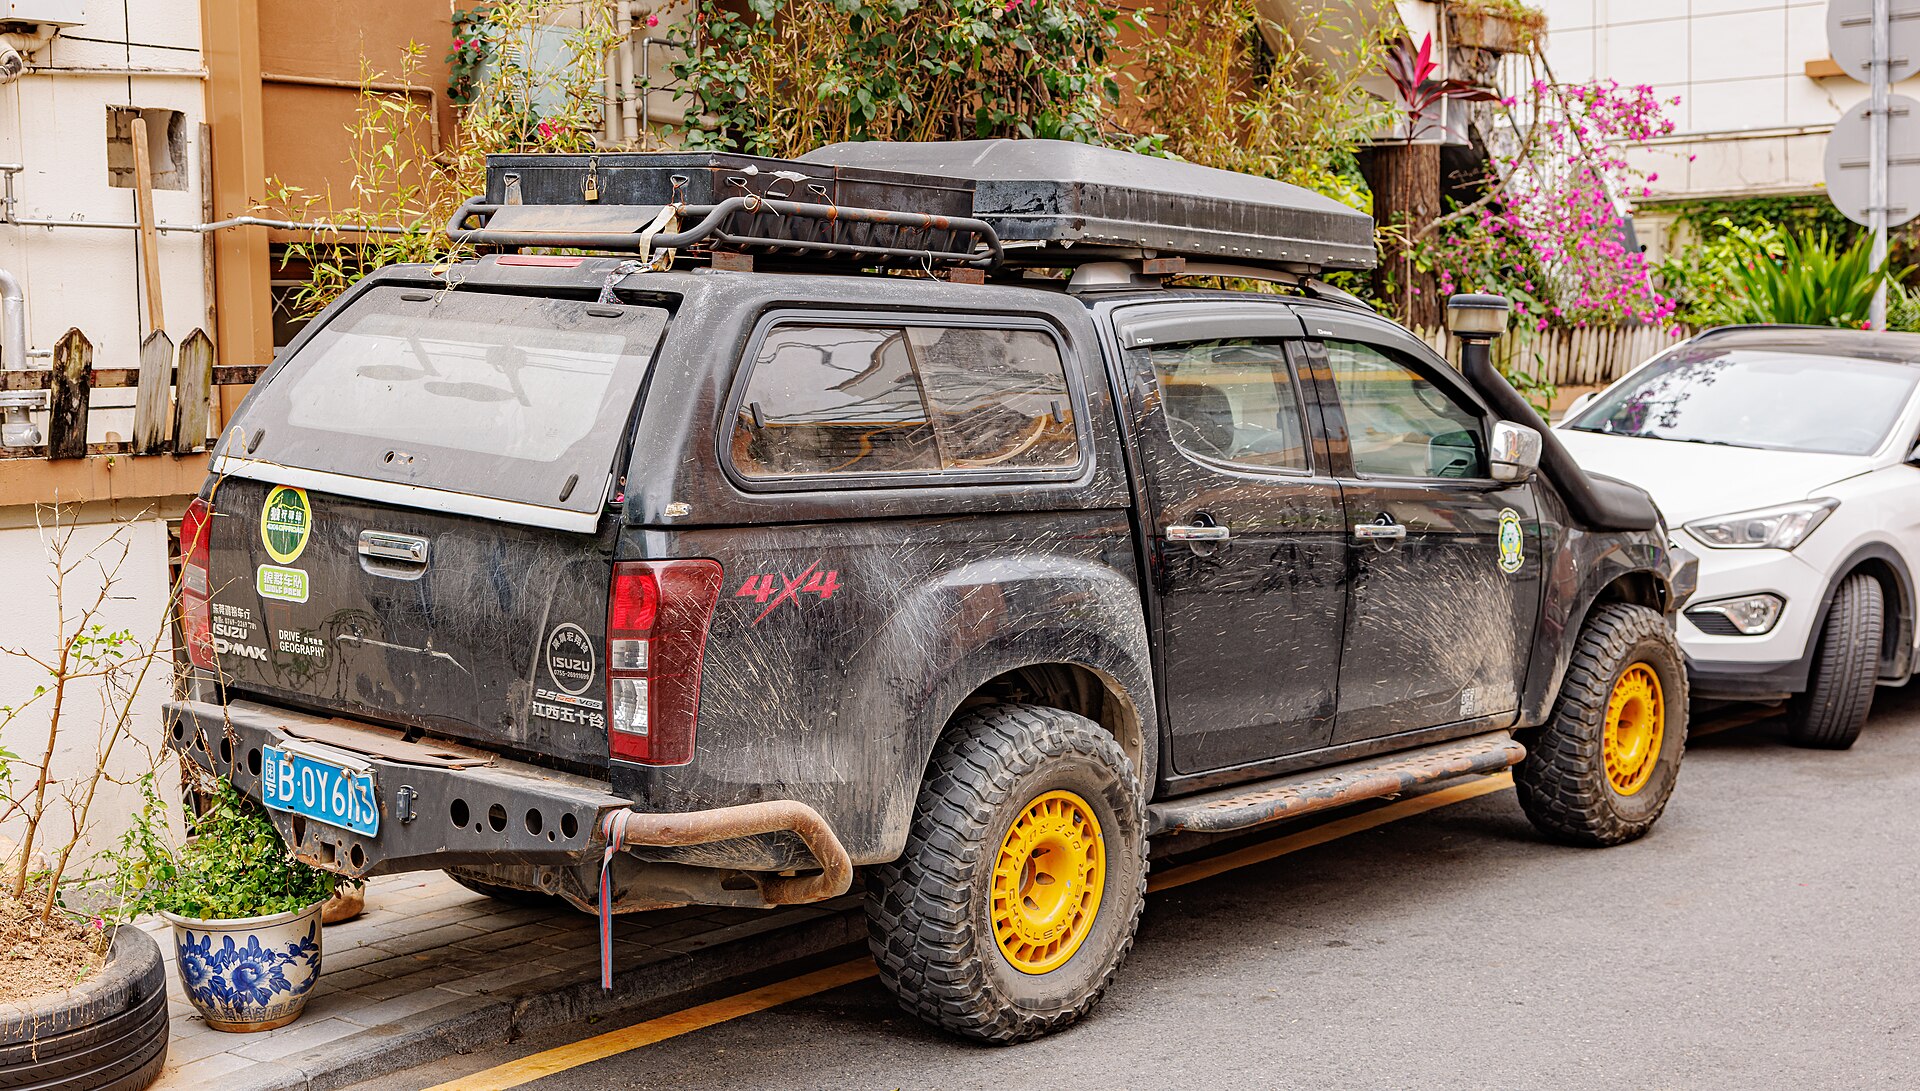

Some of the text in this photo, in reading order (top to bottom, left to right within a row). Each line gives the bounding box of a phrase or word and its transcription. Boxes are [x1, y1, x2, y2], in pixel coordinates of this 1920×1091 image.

[212, 623, 248, 640] ISUZU
[278, 629, 301, 643] DRIVE
[279, 640, 325, 658] GEOGRAPHY
[552, 656, 590, 672] ISUZU
[532, 700, 606, 730] 江西五十铃
